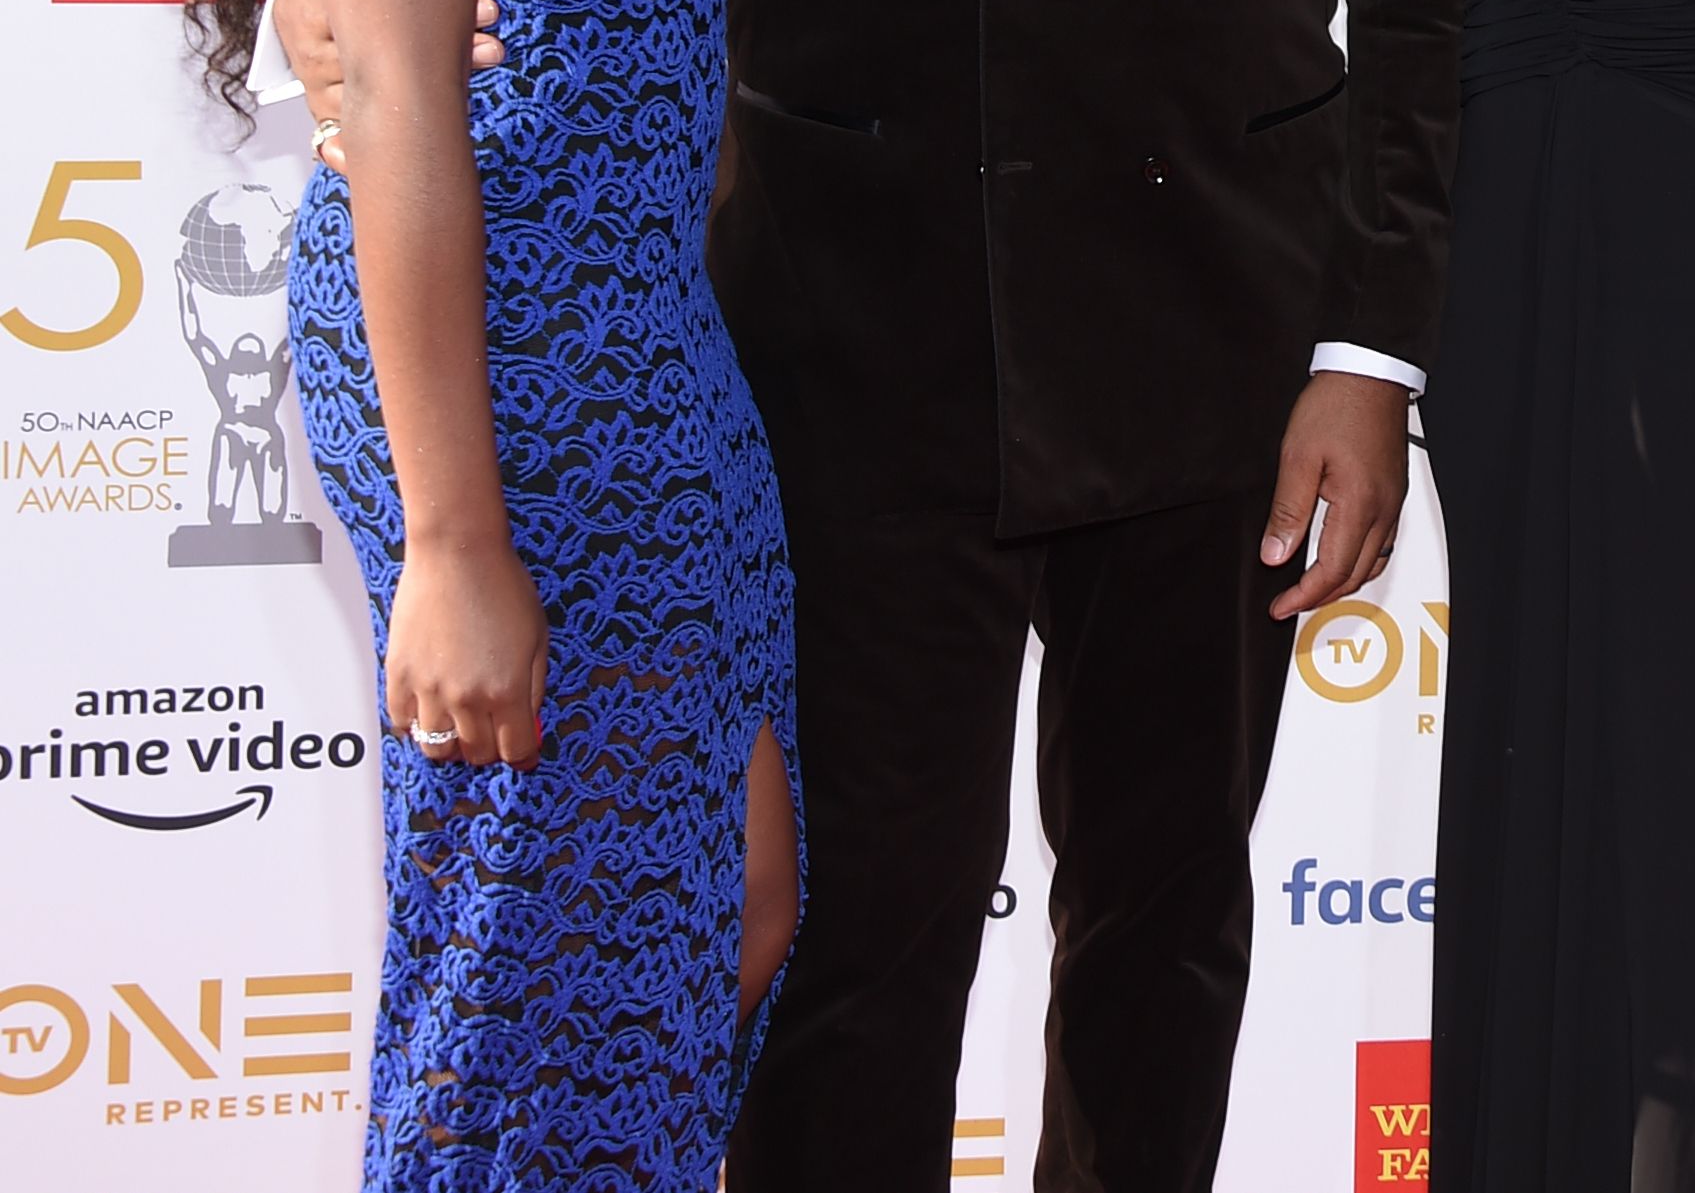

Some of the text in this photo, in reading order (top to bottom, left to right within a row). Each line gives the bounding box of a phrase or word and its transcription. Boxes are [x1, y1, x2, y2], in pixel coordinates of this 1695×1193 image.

[77, 409, 174, 432] NAACP
[2, 436, 189, 480] IMAGE
[1327, 638, 1372, 664] TV
[74, 682, 265, 718] amazon
[186, 719, 366, 773] video
[1282, 857, 1435, 926] face
[0, 972, 354, 1097] TV ONE
